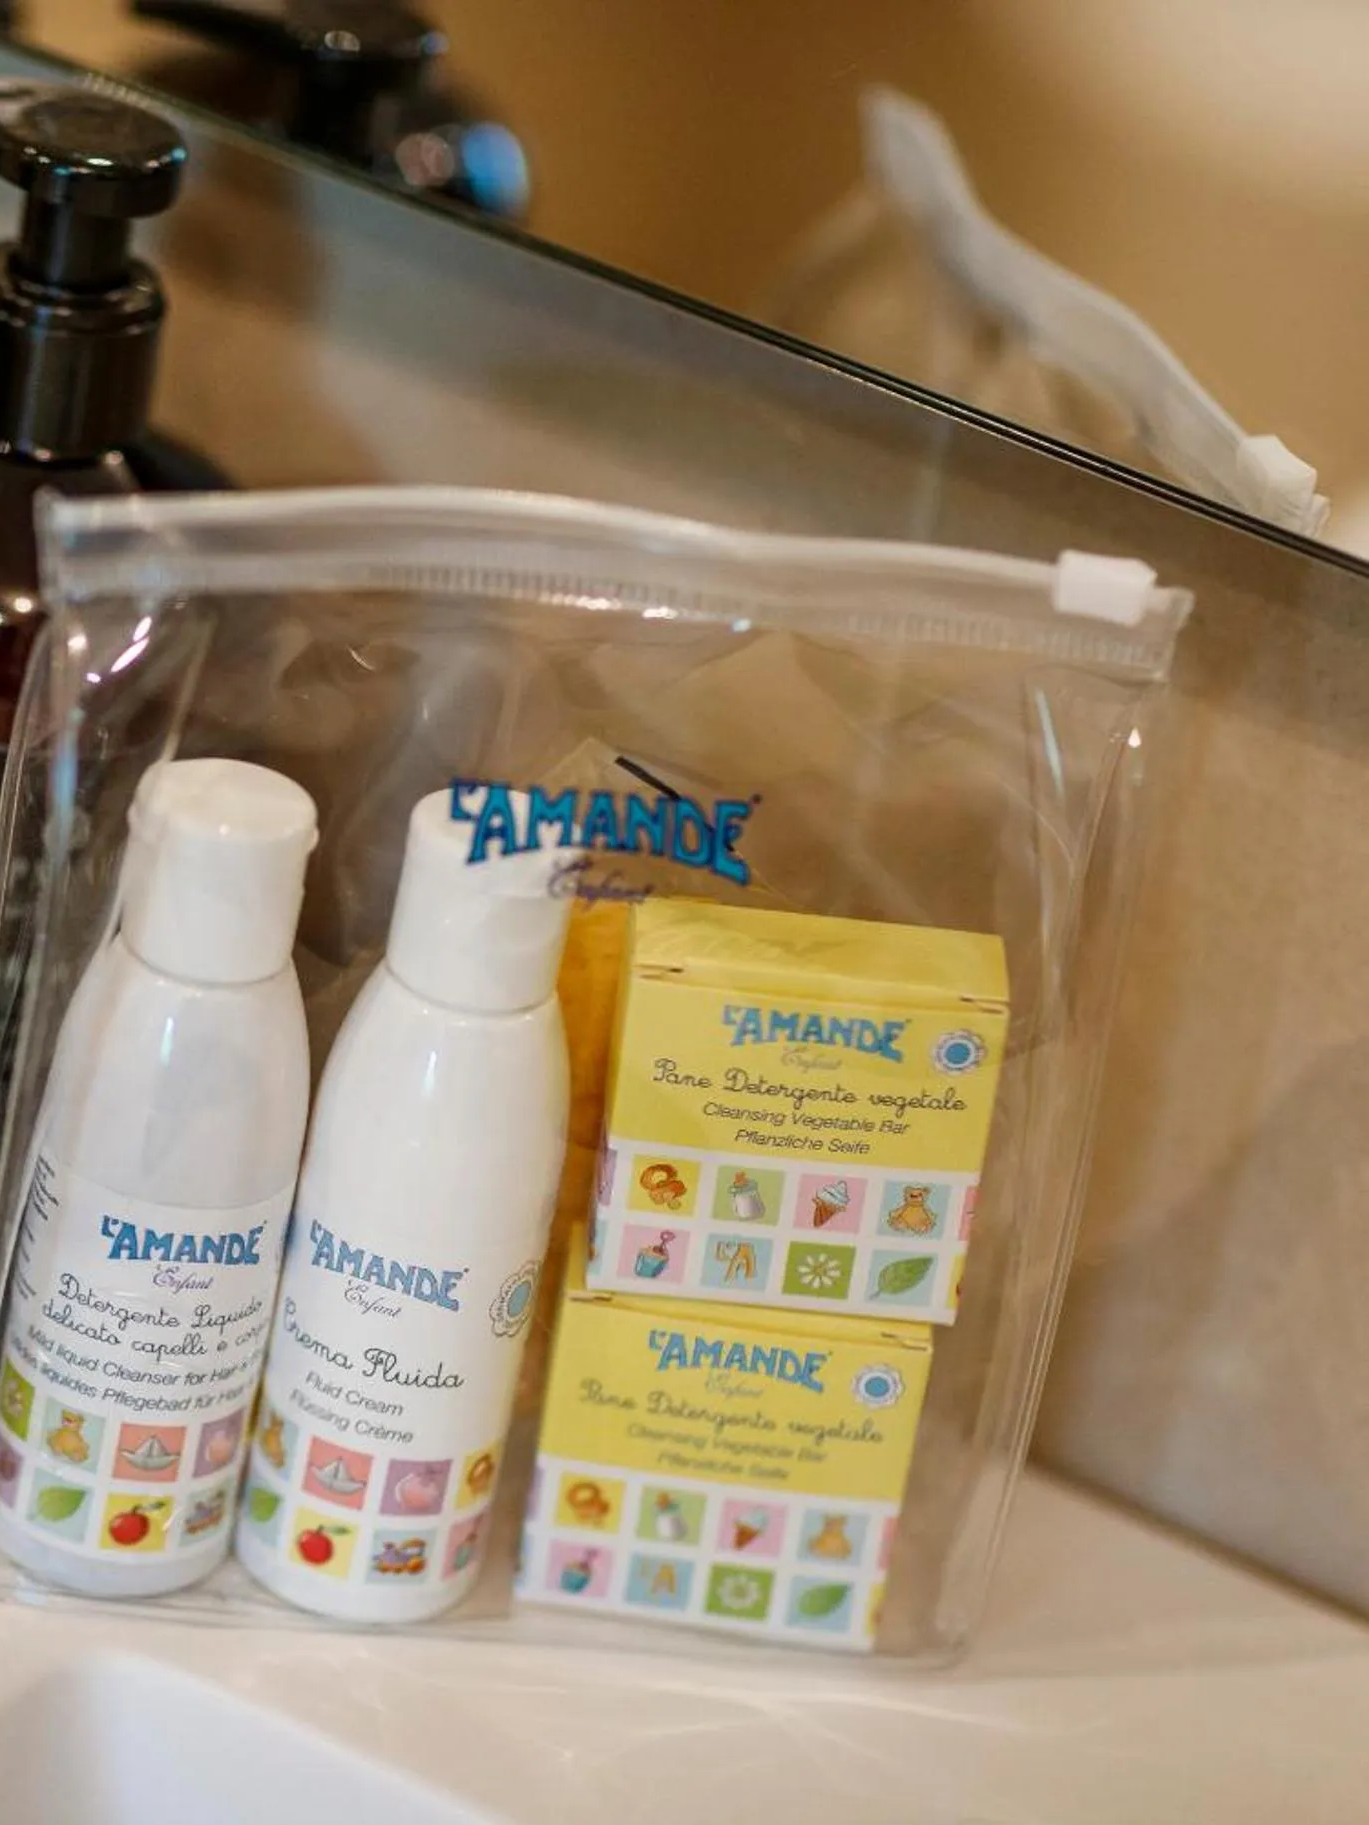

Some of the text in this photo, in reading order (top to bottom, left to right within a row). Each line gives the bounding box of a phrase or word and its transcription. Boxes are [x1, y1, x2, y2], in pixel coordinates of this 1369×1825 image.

[449, 777, 752, 887] L'AMANDE
[722, 1004, 908, 1064] L'AMANDE
[652, 1057, 968, 1119] Pane Detergente vegetale
[703, 1101, 911, 1135] Cleansing Vegetable Bar
[734, 1128, 870, 1155] Pflanzliche Seife
[100, 1214, 264, 1265] L'AMANDE
[310, 1219, 465, 1312] L'AMANDE
[58, 1272, 181, 1330] Detergente
[42, 1300, 122, 1346] delicato
[132, 1333, 208, 1364] capelli
[217, 1340, 228, 1353] e
[57, 1341, 99, 1373] liquid
[102, 1360, 180, 1387] Cleanser
[183, 1368, 209, 1386] for
[362, 1347, 465, 1389] Fluida
[648, 1329, 830, 1394] L'AMANDE
[102, 1387, 193, 1412] Pflegebad
[305, 1370, 405, 1417] Fluid Cream
